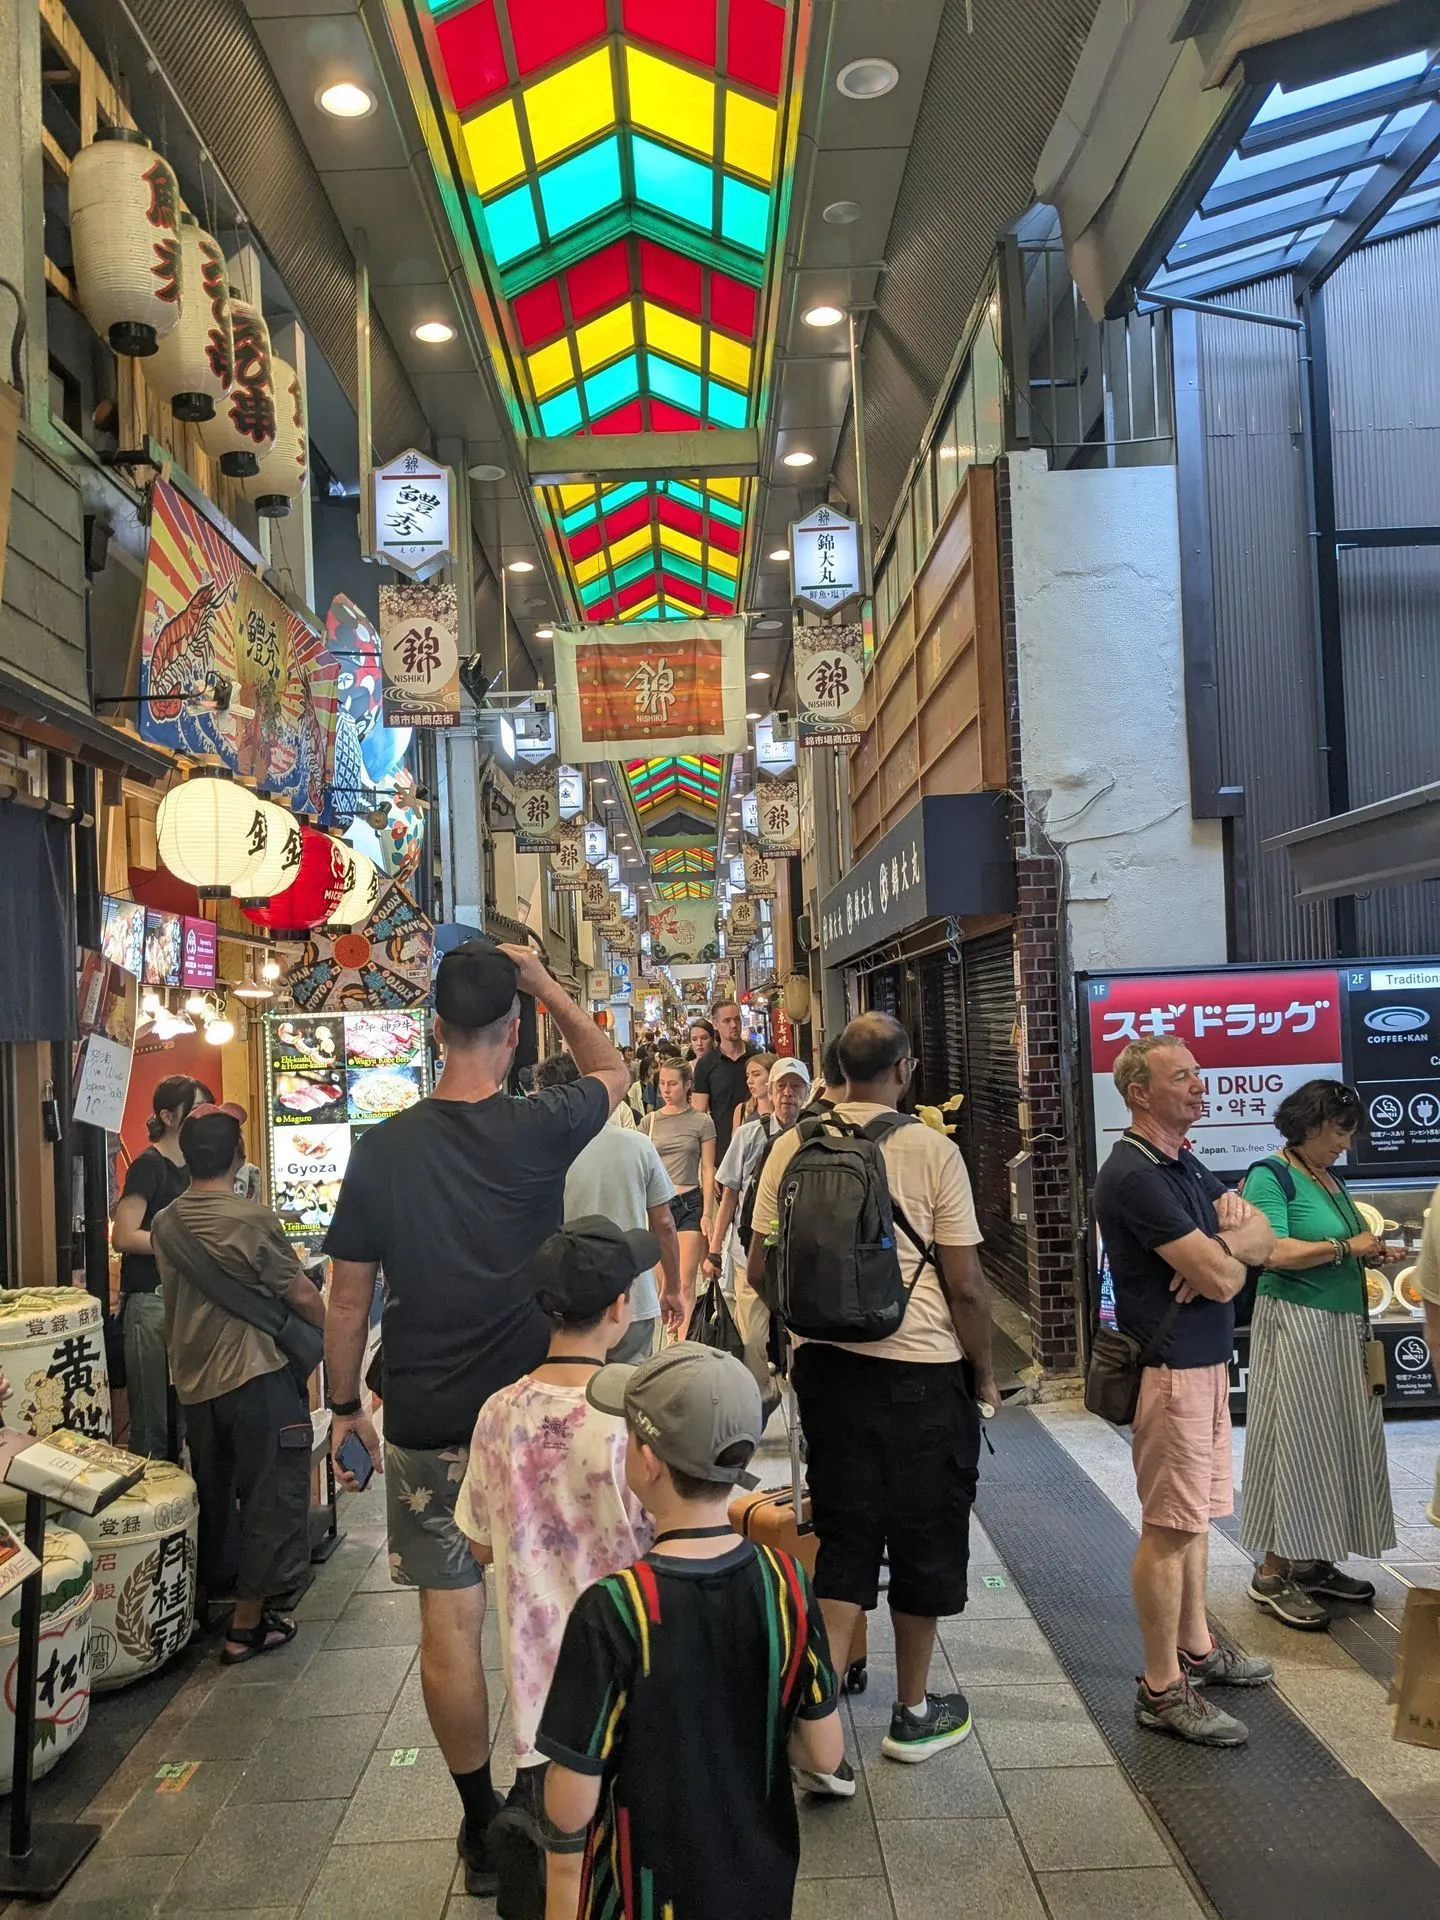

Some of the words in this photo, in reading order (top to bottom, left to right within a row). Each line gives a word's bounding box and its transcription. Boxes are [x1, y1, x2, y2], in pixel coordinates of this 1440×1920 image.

[817, 533, 836, 584] 錦大丸
[393, 626, 442, 685] 錦
[394, 675, 425, 683] NISHIKI
[807, 658, 850, 708] 錦
[624, 657, 676, 727] 錦
[808, 701, 836, 709] NISHIKI
[390, 714, 454, 726] 錦市場商店街
[636, 715, 663, 723] NISHIKI
[805, 735, 861, 747] 錦市場商店街
[522, 795, 550, 828] 錦
[764, 804, 790, 836] 錦
[1352, 974, 1364, 984] 2F
[1093, 984, 1106, 995] 1F
[1217, 1074, 1284, 1095] DRUG
[283, 1115, 312, 1124] Maguro
[1232, 1144, 1264, 1153] Tax-free
[287, 1163, 337, 1176] Gyoza
[99, 1514, 141, 1537] 登録
[149, 1529, 188, 1664] 月桂冠
